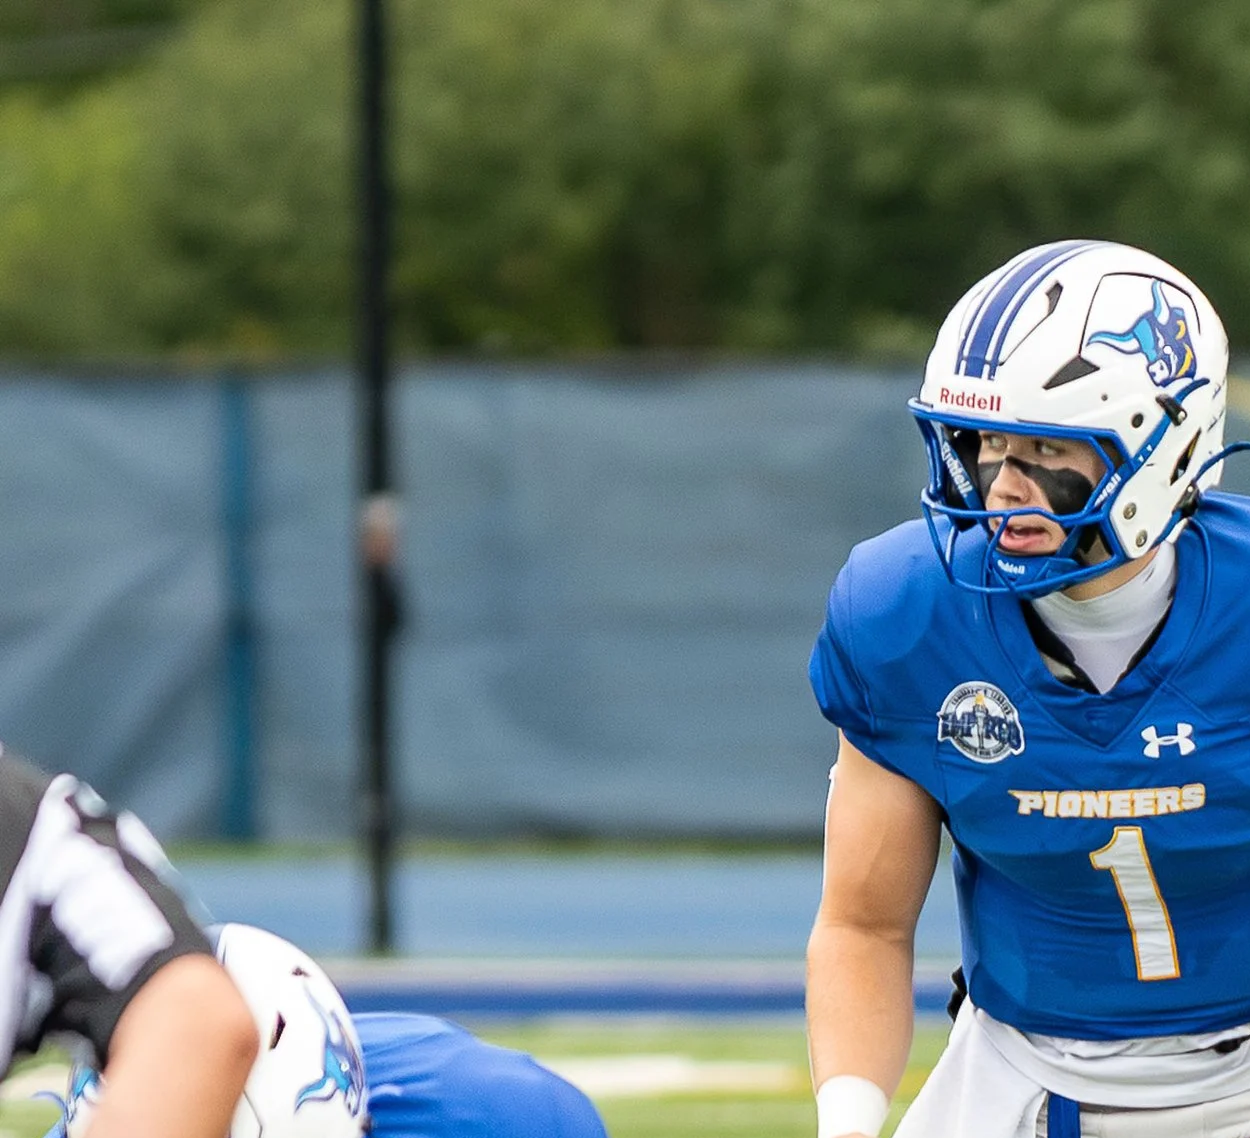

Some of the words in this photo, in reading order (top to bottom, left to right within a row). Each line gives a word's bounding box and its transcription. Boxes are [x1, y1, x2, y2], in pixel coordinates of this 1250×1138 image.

[940, 387, 1003, 412] Riddell
[1007, 782, 1206, 819] PIONEERS
[1088, 825, 1182, 981] 1
